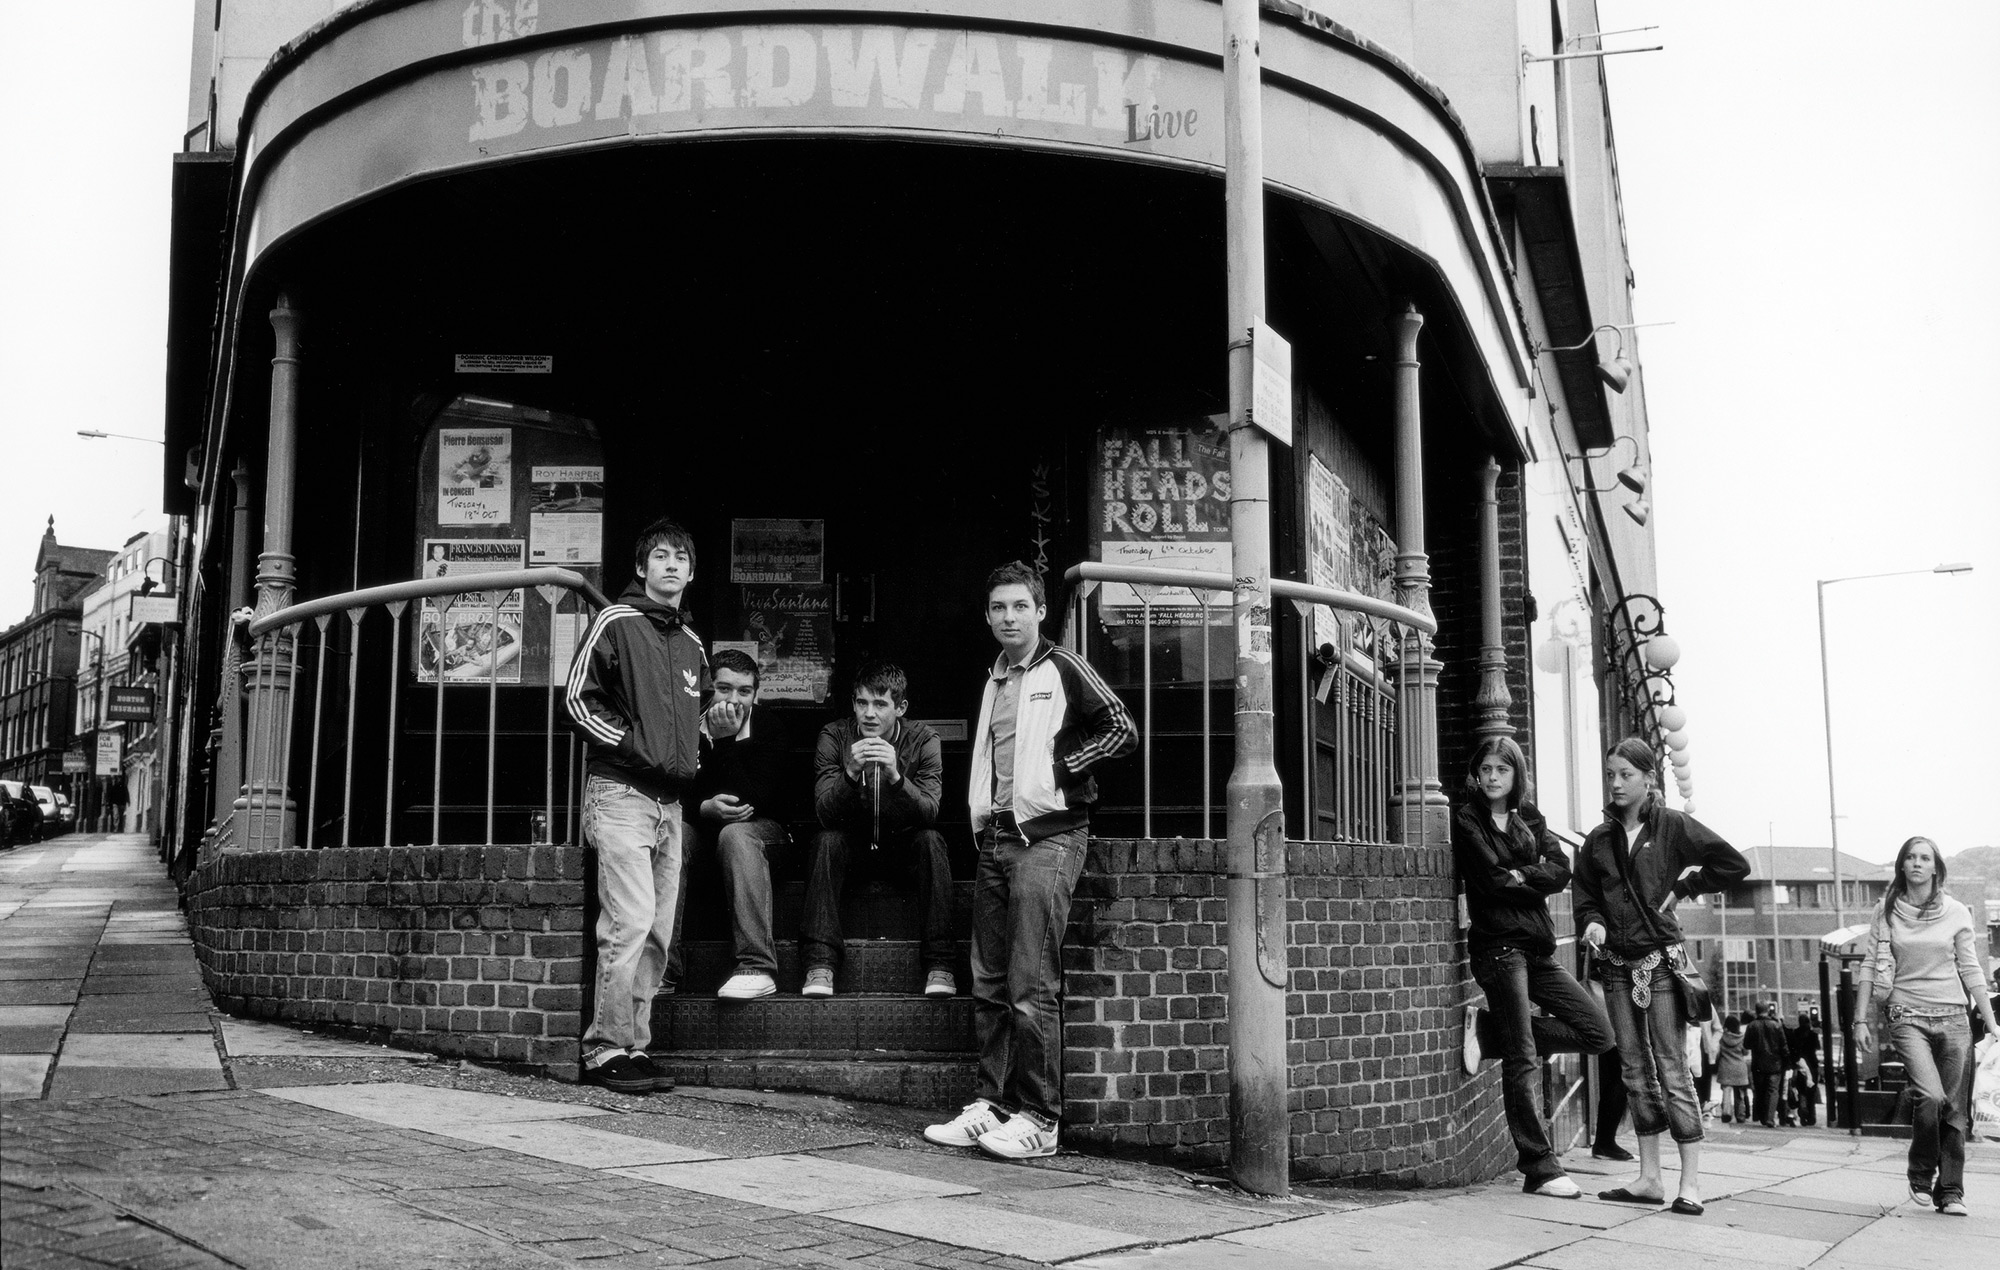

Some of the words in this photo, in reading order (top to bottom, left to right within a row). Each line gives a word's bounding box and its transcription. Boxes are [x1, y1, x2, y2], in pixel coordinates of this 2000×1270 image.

[463, 0, 538, 47] the
[469, 28, 1161, 143] BOARDWALK
[1124, 103, 1197, 143] Live
[444, 435, 466, 446] Pierre
[467, 435, 503, 446] Bensusan
[1103, 439, 1192, 468] FALL
[1198, 444, 1211, 455] The
[1212, 448, 1226, 458] Fall
[535, 470, 555, 478] ROY
[560, 469, 600, 478] HARPER
[1103, 469, 1232, 501] HEADS
[443, 487, 449, 496] IN
[450, 487, 475, 496] CONCERT
[1103, 501, 1209, 533] ROLL
[451, 544, 482, 553] FRANCIS
[484, 544, 520, 553] DUNNERY
[1117, 544, 1153, 560] Thursday
[733, 554, 767, 563] MONDAY
[733, 572, 792, 581] BOARDWALK
[465, 592, 479, 602] 28th
[1180, 619, 1198, 627] Slogan
[117, 695, 145, 703] NORTON
[110, 705, 150, 713] INSURANCE
